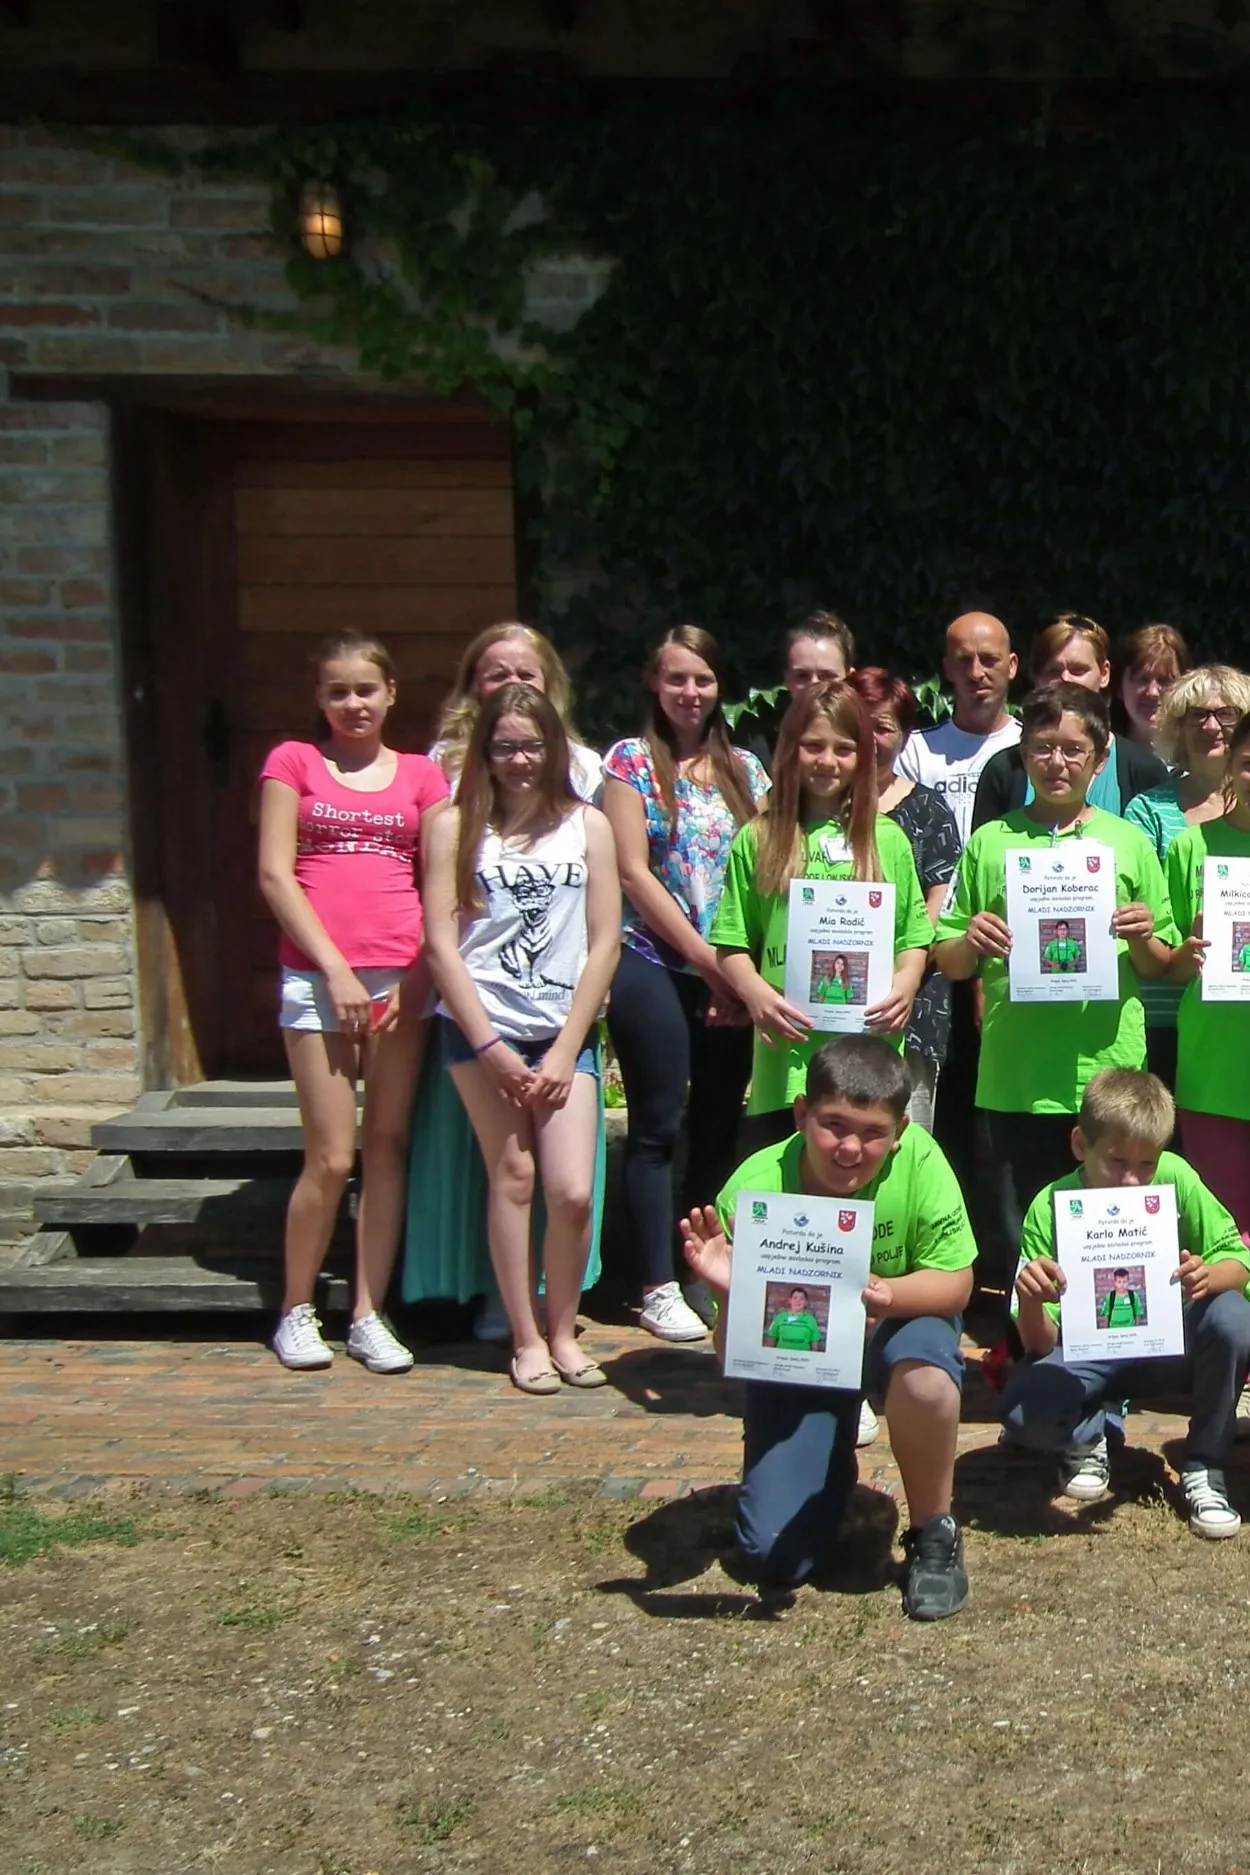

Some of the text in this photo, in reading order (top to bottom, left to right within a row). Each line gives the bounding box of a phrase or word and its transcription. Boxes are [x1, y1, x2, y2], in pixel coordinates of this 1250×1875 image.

[934, 776, 978, 793] adi
[312, 802, 405, 827] Shortest
[304, 821, 363, 838] orror
[472, 862, 585, 895] HAVE
[1022, 884, 1099, 895] Dorijan Koberac
[1028, 906, 1050, 914] MLADI
[819, 916, 865, 926] Mia Radić
[1086, 1226, 1148, 1240] Karlo Matić
[760, 1239, 844, 1255] Andrej Kušina
[1081, 1251, 1156, 1263] MLADI NADZORNIK
[757, 1265, 843, 1279] MLADI NADZORNIK
